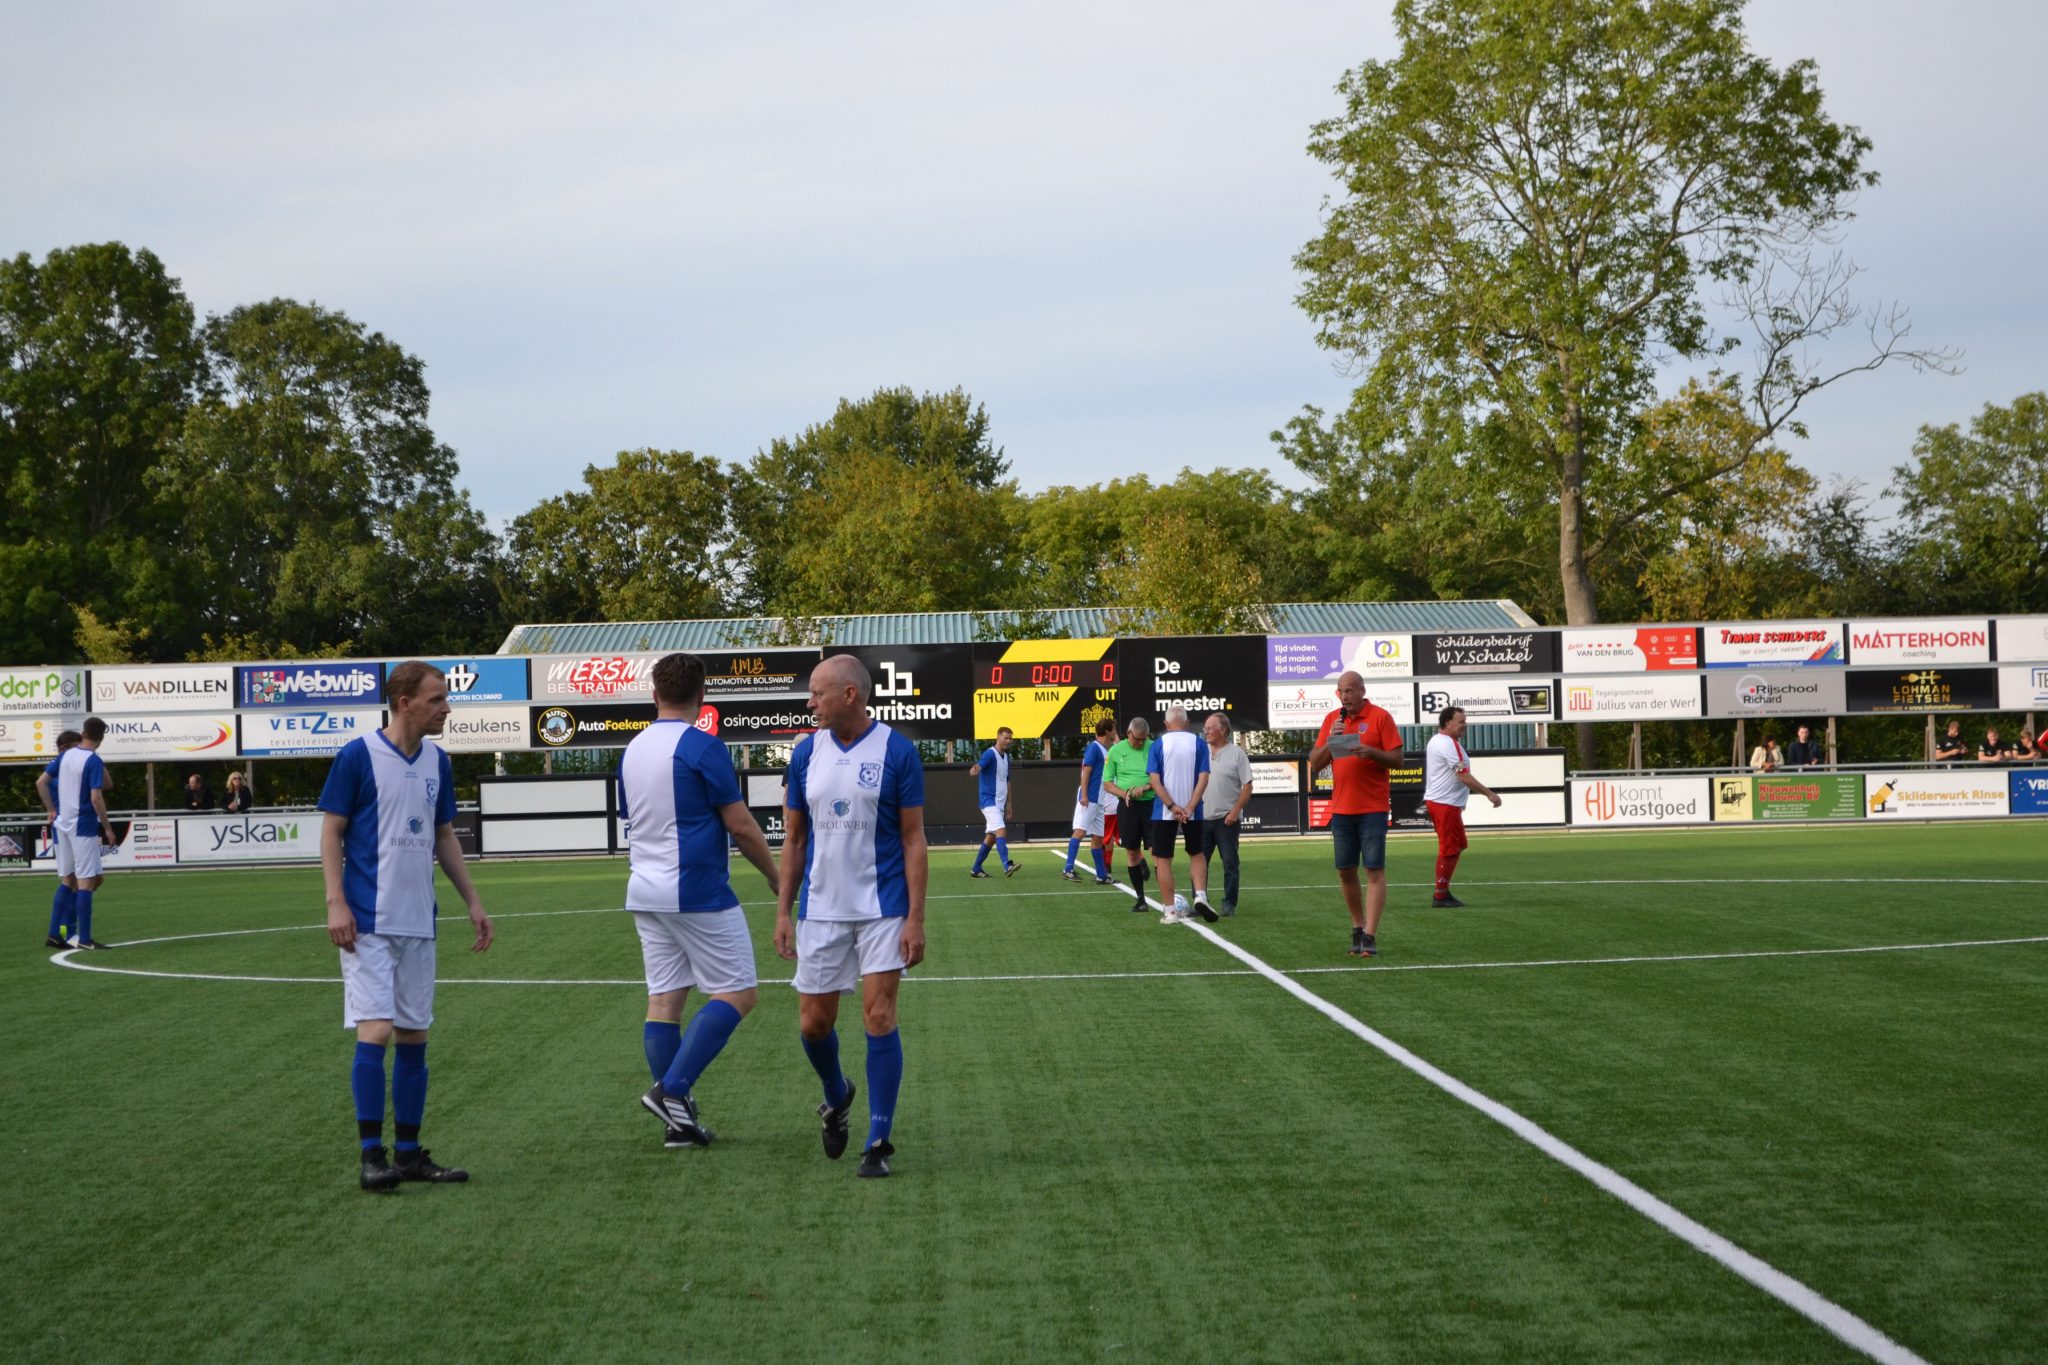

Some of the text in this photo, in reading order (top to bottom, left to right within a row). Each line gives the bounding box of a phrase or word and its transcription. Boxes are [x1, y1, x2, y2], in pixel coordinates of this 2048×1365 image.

[1436, 634, 1533, 648] Schildersbedrijf
[1721, 629, 1826, 644] TIMME SCHILDERS
[1853, 630, 1985, 649] MATTERHORN
[1274, 644, 1288, 653] Tijd
[1902, 650, 1937, 658] coaching
[1274, 655, 1288, 664] tijd
[1436, 648, 1533, 664] W.Y.Schakel
[547, 657, 659, 681] WIERSMA
[1103, 664, 1114, 681] 0
[1155, 657, 1181, 674] De
[1275, 665, 1288, 674] tijd
[704, 676, 794, 686] AUTOMOTIVE BOLSWARD
[992, 666, 1003, 684] 0
[1032, 665, 1072, 683] 0:00
[45, 672, 81, 697] Pol
[123, 680, 227, 695] VANDILLEN
[548, 680, 655, 694] BESTRATINGEN
[1756, 684, 1818, 695] Rijschool
[1893, 685, 1950, 695] LOHMAN
[471, 693, 503, 701] BOLSWARD
[977, 692, 1015, 703] THUIS
[1034, 692, 1060, 702] MIN
[1095, 689, 1118, 700] UIT
[1596, 689, 1654, 697] Tegelgroothandel
[1743, 695, 1782, 704] Richard
[1893, 694, 1951, 704] FIETSEN
[2, 700, 81, 711] installatiebedrijf
[1155, 696, 1233, 712] meester.
[1275, 701, 1330, 709] FlexFirst
[1452, 697, 1508, 707] aluminiumbouw
[1596, 697, 1697, 711] Julius van der Werf
[546, 710, 567, 719] AUTO
[865, 703, 952, 721] orritsma
[269, 712, 355, 734] VELZEN
[449, 719, 521, 733] keukens
[578, 718, 651, 732] AutoFoekem
[694, 712, 712, 731] dj
[723, 712, 819, 729] osingadejong
[115, 734, 213, 744] verkeersopleidingen
[270, 737, 351, 747] textielreinigin
[449, 736, 521, 745] bkbbolsward.nl
[541, 727, 573, 744] FOEKEMA
[1619, 785, 1663, 801] komt
[1897, 790, 2005, 801] Skilderwurk Rinse
[1619, 799, 1696, 820] vastgoed
